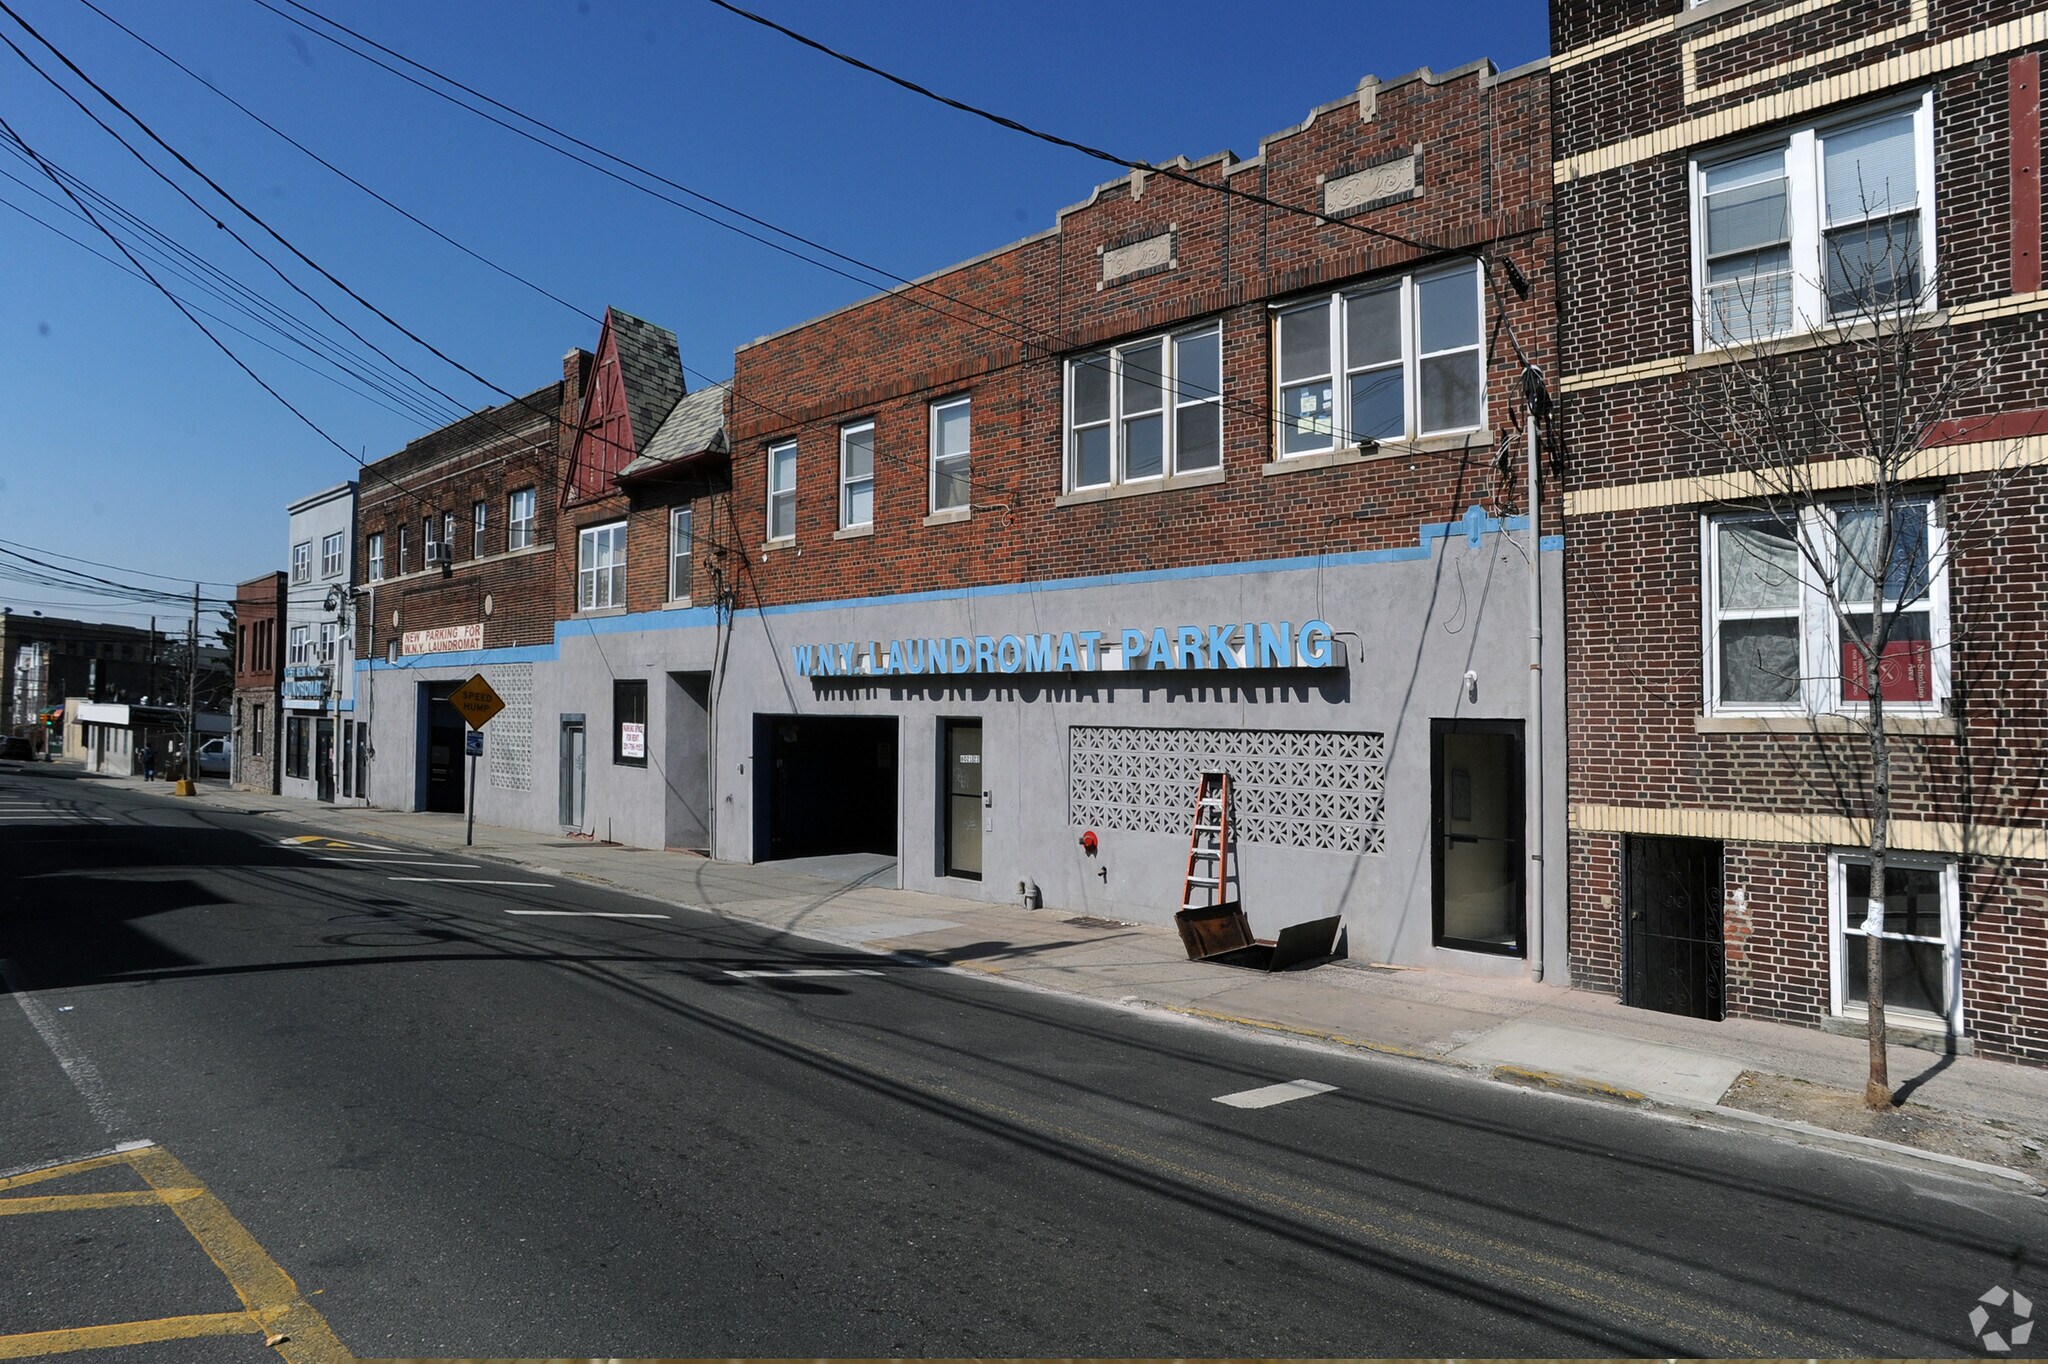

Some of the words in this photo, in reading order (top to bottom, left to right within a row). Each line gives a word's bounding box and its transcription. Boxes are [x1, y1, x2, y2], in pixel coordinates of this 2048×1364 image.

[405, 633, 419, 643] NEW
[425, 627, 458, 641] PARKING
[464, 625, 480, 637] FOR
[405, 643, 424, 654] W.N.Y.
[428, 639, 480, 652] LAUNDROMAT
[792, 642, 861, 676] W.N.Y.
[868, 630, 1103, 676] LAUNDROMAT
[1121, 620, 1333, 671] PARKING
[1908, 663, 1916, 681] Area
[463, 691, 492, 702] SPEED
[464, 702, 490, 712] HUMP
